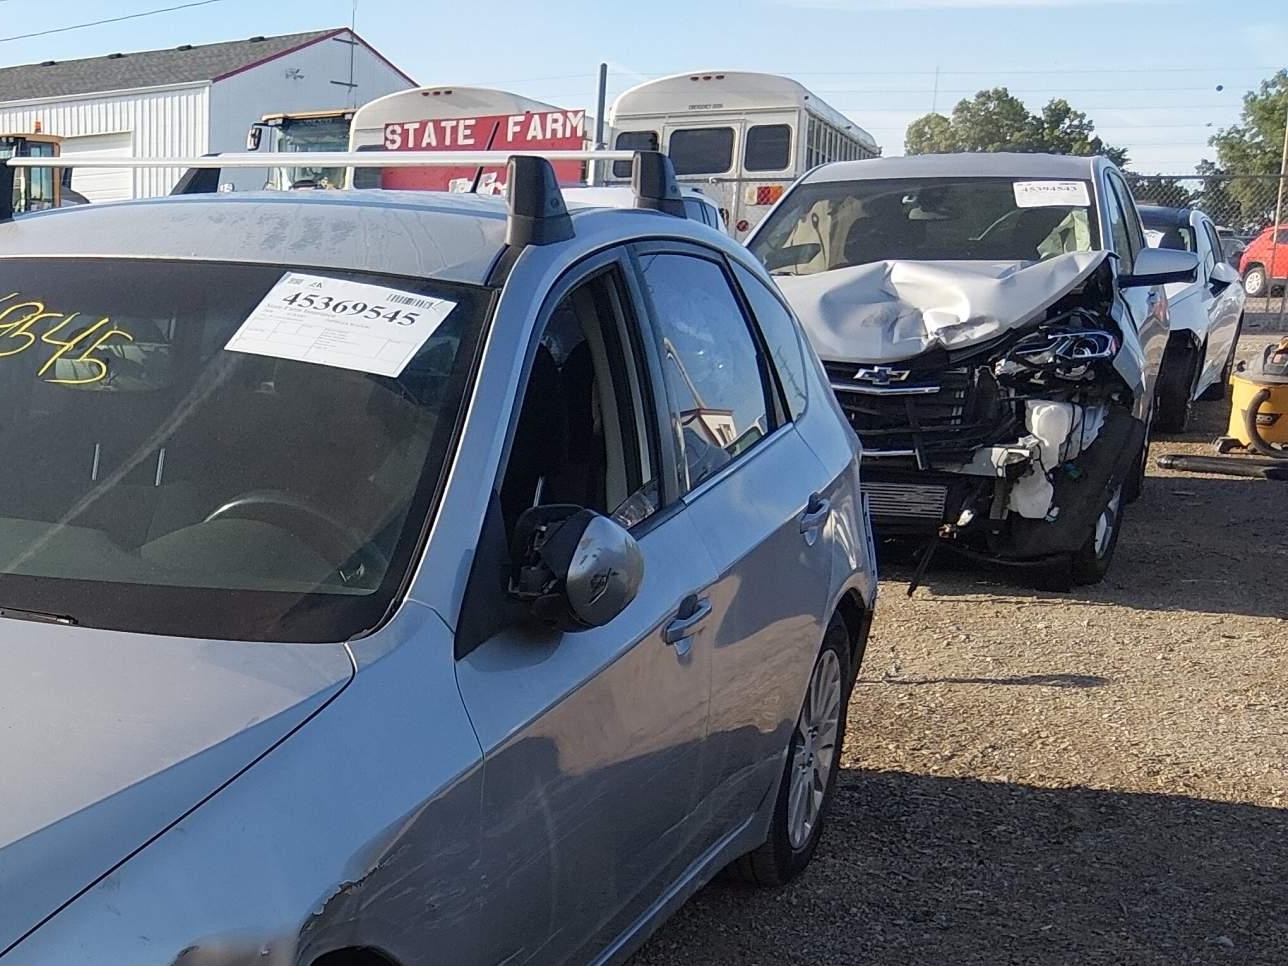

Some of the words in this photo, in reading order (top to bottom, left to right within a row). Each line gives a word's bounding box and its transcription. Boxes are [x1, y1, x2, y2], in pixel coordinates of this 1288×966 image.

[385, 119, 476, 150] STATE
[507, 111, 584, 142] FARM
[282, 291, 421, 327] 45369545
